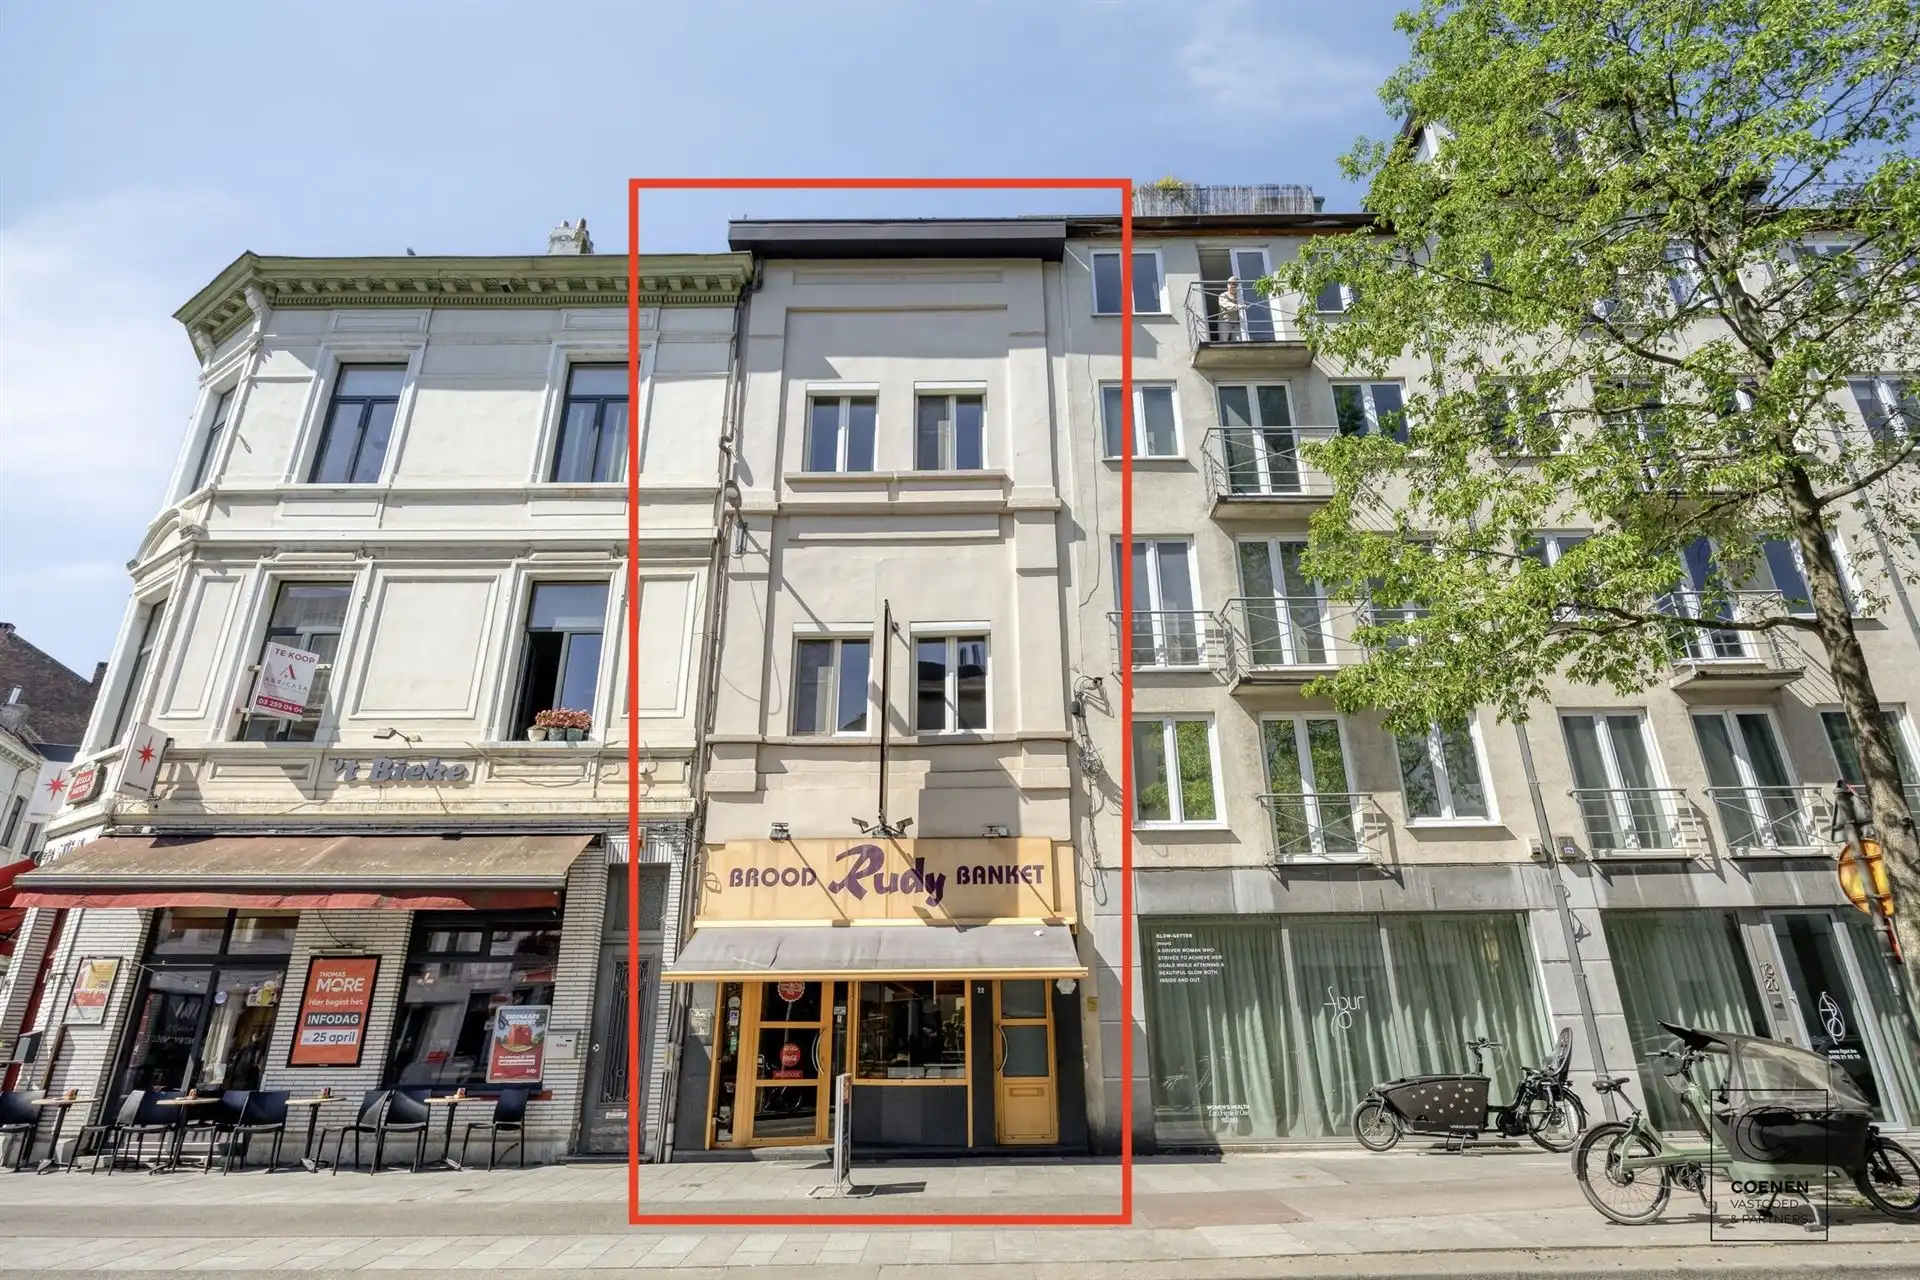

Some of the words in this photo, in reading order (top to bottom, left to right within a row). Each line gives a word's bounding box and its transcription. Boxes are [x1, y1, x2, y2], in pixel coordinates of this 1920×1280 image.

[275, 648, 287, 657] TE
[288, 652, 315, 664] KOOP
[269, 701, 283, 710] 259
[283, 704, 293, 712] 04
[367, 757, 470, 783] Bieke
[729, 867, 818, 888] BROOD
[828, 844, 946, 907] Rudy
[956, 865, 1045, 885] BANKET
[316, 978, 366, 993] MORE
[325, 998, 349, 1007] begint
[307, 1014, 359, 1025] INFODAG
[312, 1032, 327, 1042] 25
[328, 1031, 356, 1044] april
